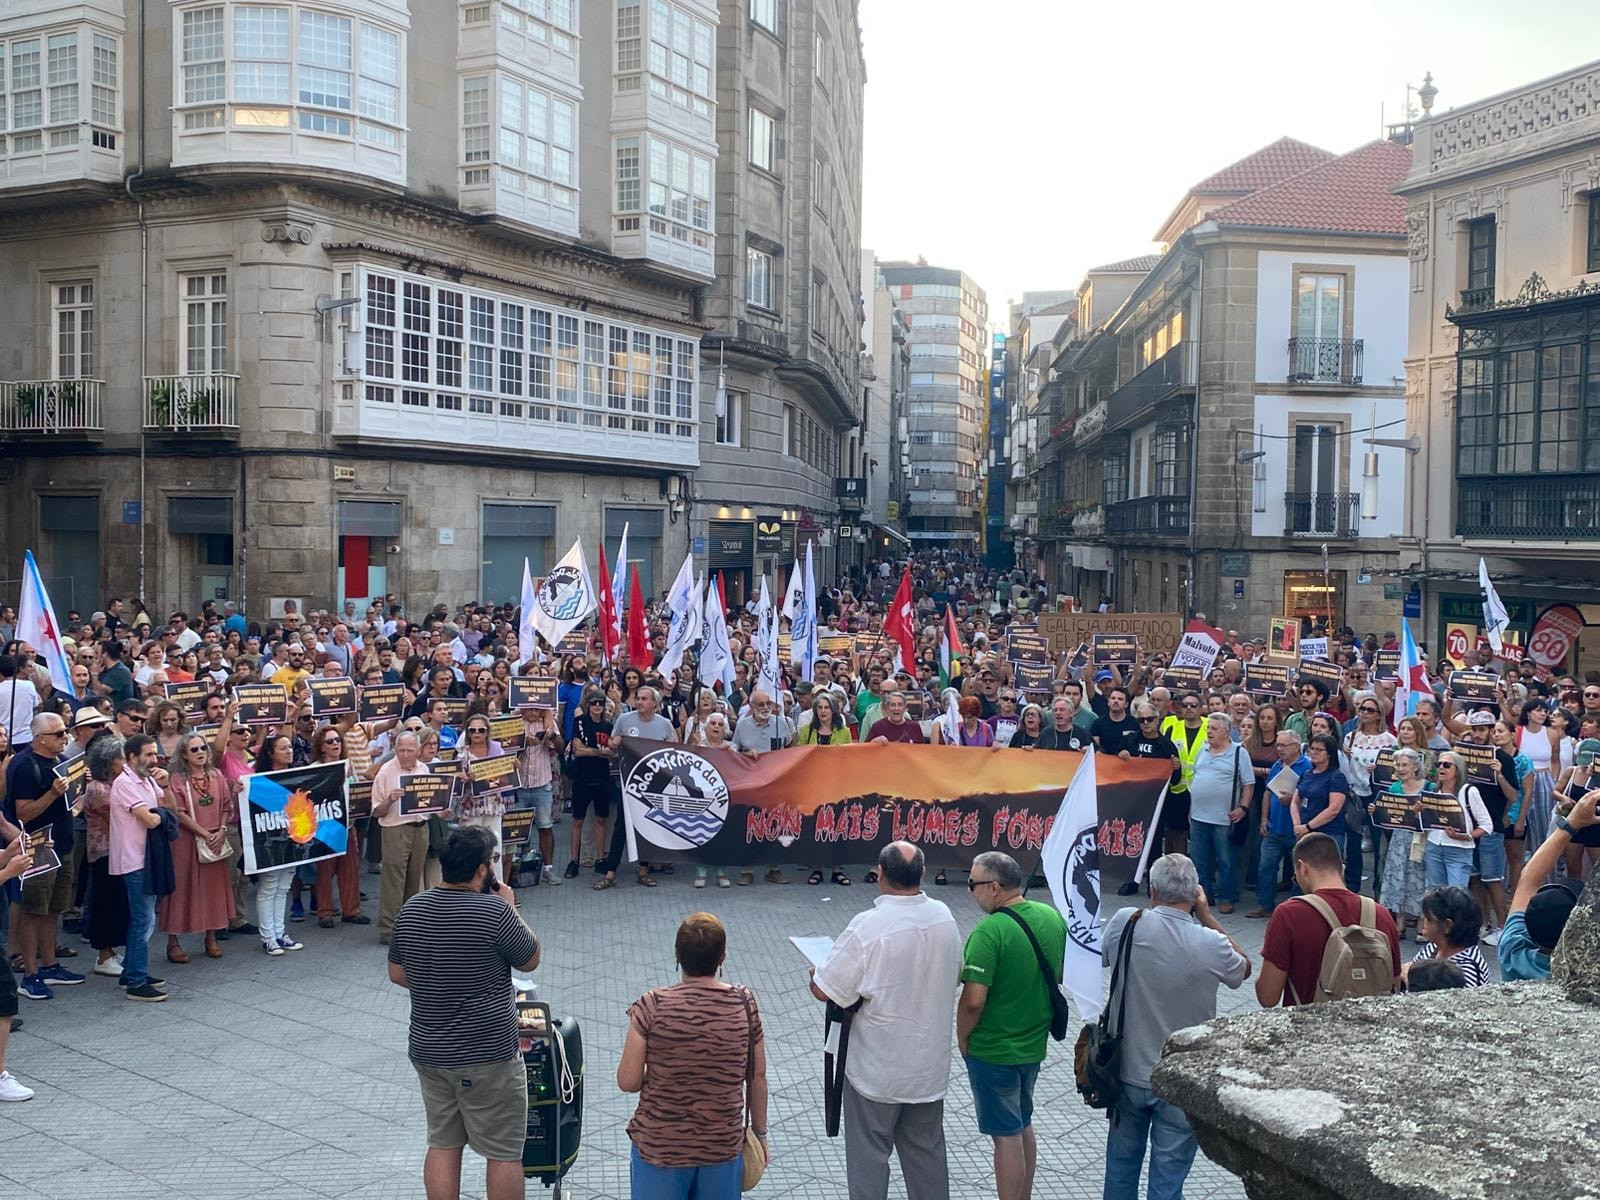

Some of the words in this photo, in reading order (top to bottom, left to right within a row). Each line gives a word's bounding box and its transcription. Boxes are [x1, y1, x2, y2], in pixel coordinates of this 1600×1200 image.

[1046, 618, 1101, 633] GALICIA
[1105, 619, 1172, 635] ARDIENDO
[1184, 636, 1216, 656] Malvoto
[1449, 635, 1467, 654] 70
[1532, 633, 1566, 660] 80
[628, 772, 655, 799] Pola
[647, 752, 703, 773] Defensa
[702, 769, 718, 788] da
[713, 785, 729, 809] RIA
[254, 811, 289, 833] NUN
[746, 802, 802, 844] NON
[815, 803, 881, 843] MAIS
[892, 804, 980, 846] LUMES
[991, 804, 1145, 858] FORAIS
